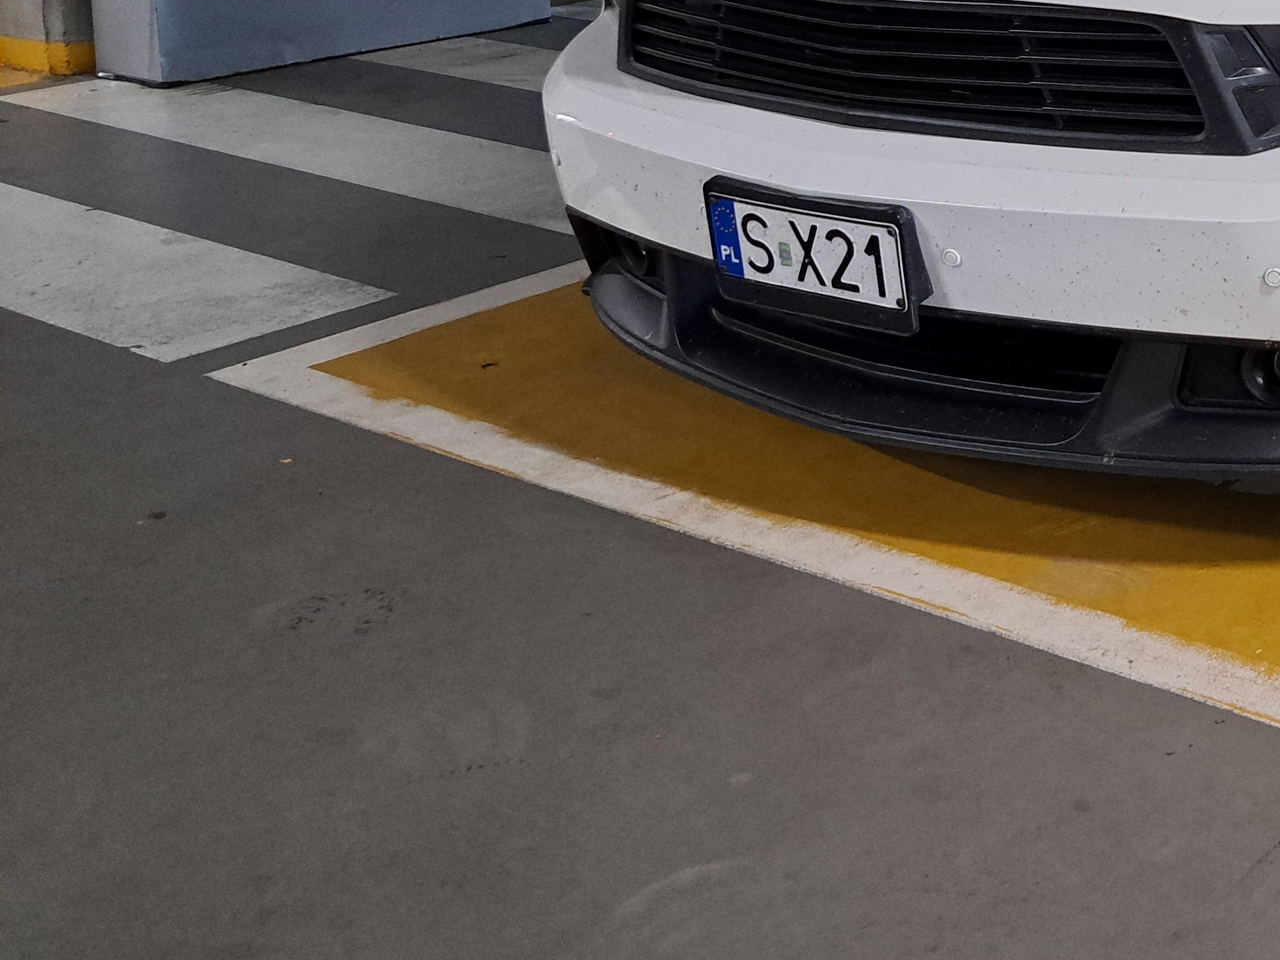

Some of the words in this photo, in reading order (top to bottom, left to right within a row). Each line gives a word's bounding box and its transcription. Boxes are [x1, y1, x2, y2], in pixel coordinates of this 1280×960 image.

[720, 244, 741, 264] PL
[741, 212, 775, 274] S
[788, 220, 887, 299] X21
